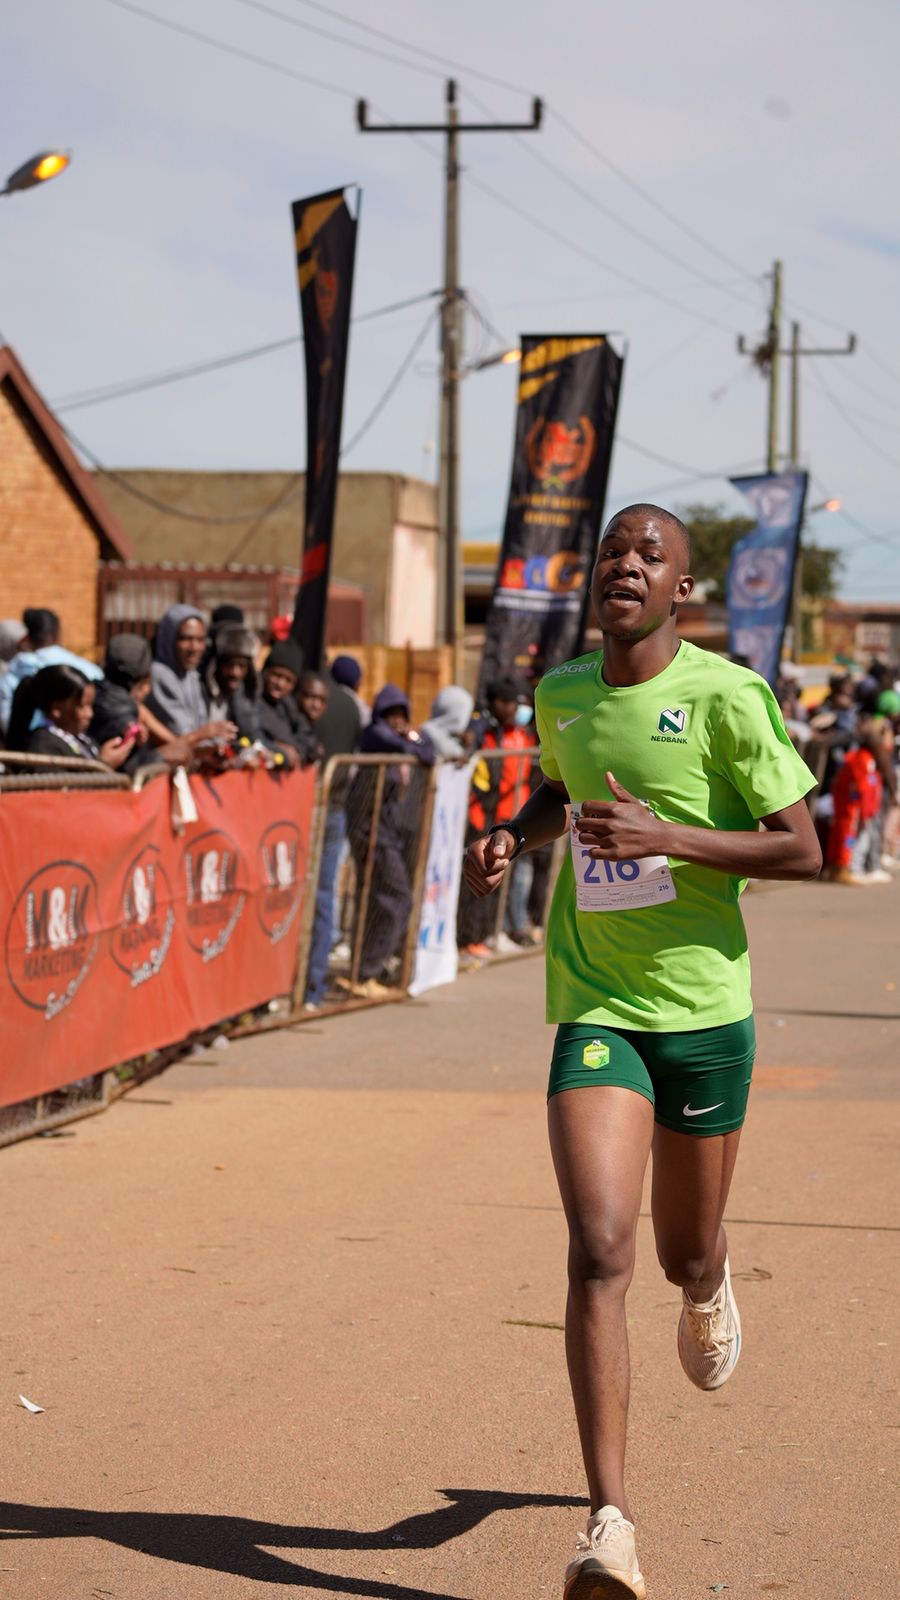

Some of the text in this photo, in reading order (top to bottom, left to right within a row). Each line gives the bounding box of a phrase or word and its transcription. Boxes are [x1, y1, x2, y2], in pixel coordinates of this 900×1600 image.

[650, 735, 689, 745] NEDBANK
[581, 849, 641, 885] 216
[658, 884, 670, 893] 216
